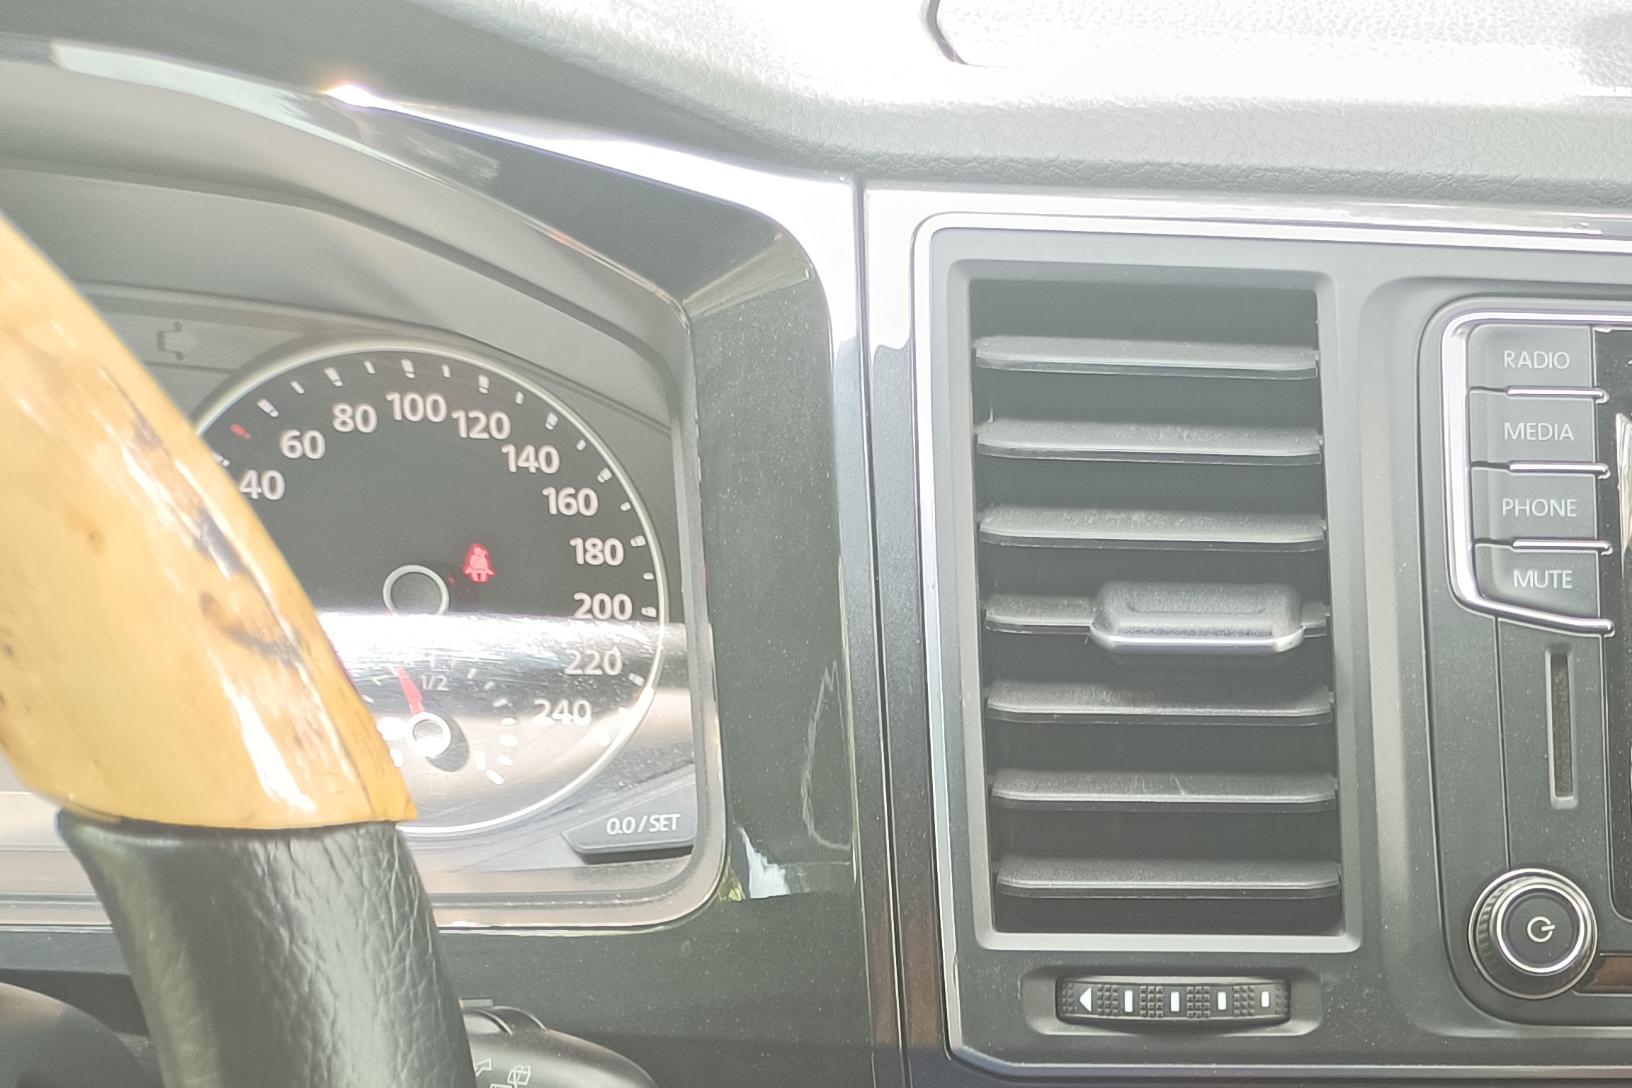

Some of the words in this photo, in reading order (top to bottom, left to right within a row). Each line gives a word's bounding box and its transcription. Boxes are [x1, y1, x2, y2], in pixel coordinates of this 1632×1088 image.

[1503, 350, 1570, 370] RADIO
[332, 404, 378, 433] 80
[386, 392, 448, 422] 100
[451, 410, 511, 440] 120
[1503, 421, 1575, 442] MEDIA
[279, 430, 326, 460] 60
[501, 443, 560, 473] 140
[239, 469, 286, 500] 40
[542, 487, 599, 517] 160
[1502, 498, 1578, 518] PHONE
[570, 537, 624, 566] 180
[1512, 569, 1573, 590] MUTE
[573, 592, 632, 622] 200
[565, 645, 623, 675] 220
[420, 674, 449, 691] 1/2
[534, 698, 592, 726] 240
